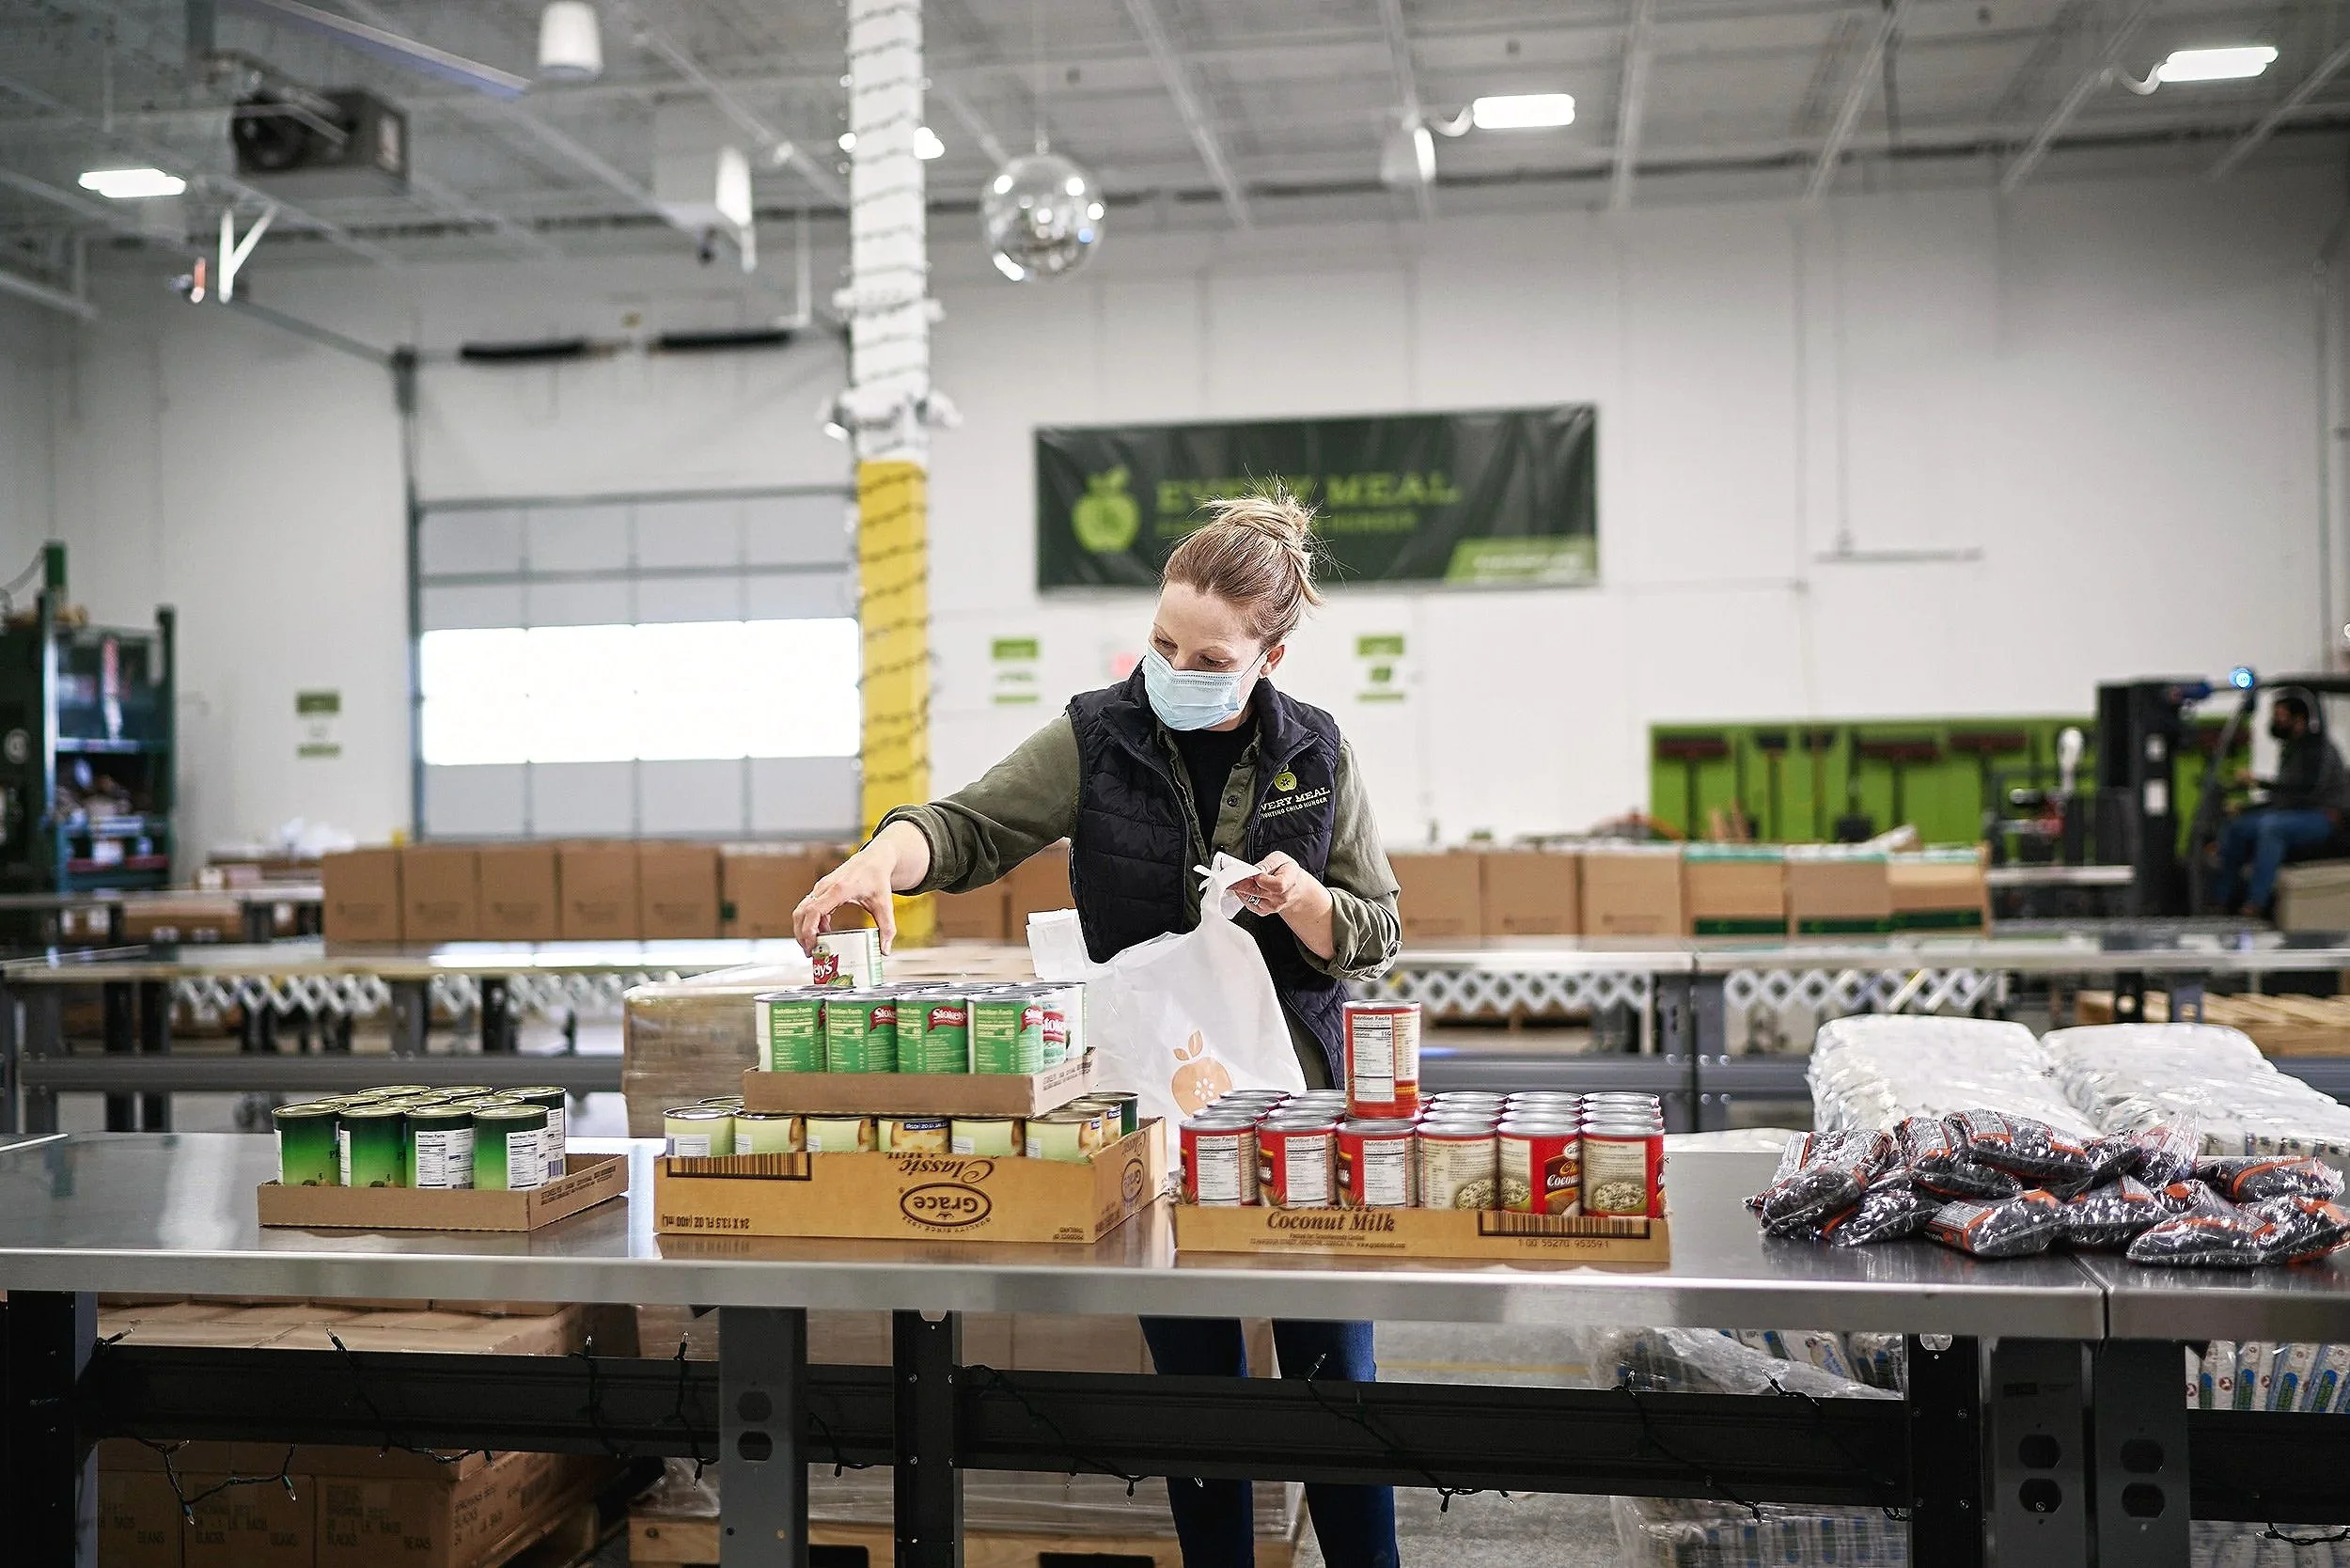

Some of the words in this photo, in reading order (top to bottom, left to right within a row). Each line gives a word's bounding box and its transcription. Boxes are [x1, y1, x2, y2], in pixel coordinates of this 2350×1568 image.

[1325, 471, 1462, 506] MEAL
[1261, 796, 1292, 811] VERY
[1295, 787, 1330, 803] MEAL
[1304, 796, 1327, 808] HUNGER
[900, 1159, 995, 1184] Classic
[913, 1196, 979, 1213] Grace
[740, 1217, 750, 1230] 24
[1267, 1209, 1346, 1231] Coconut
[1349, 1211, 1396, 1232] Milk
